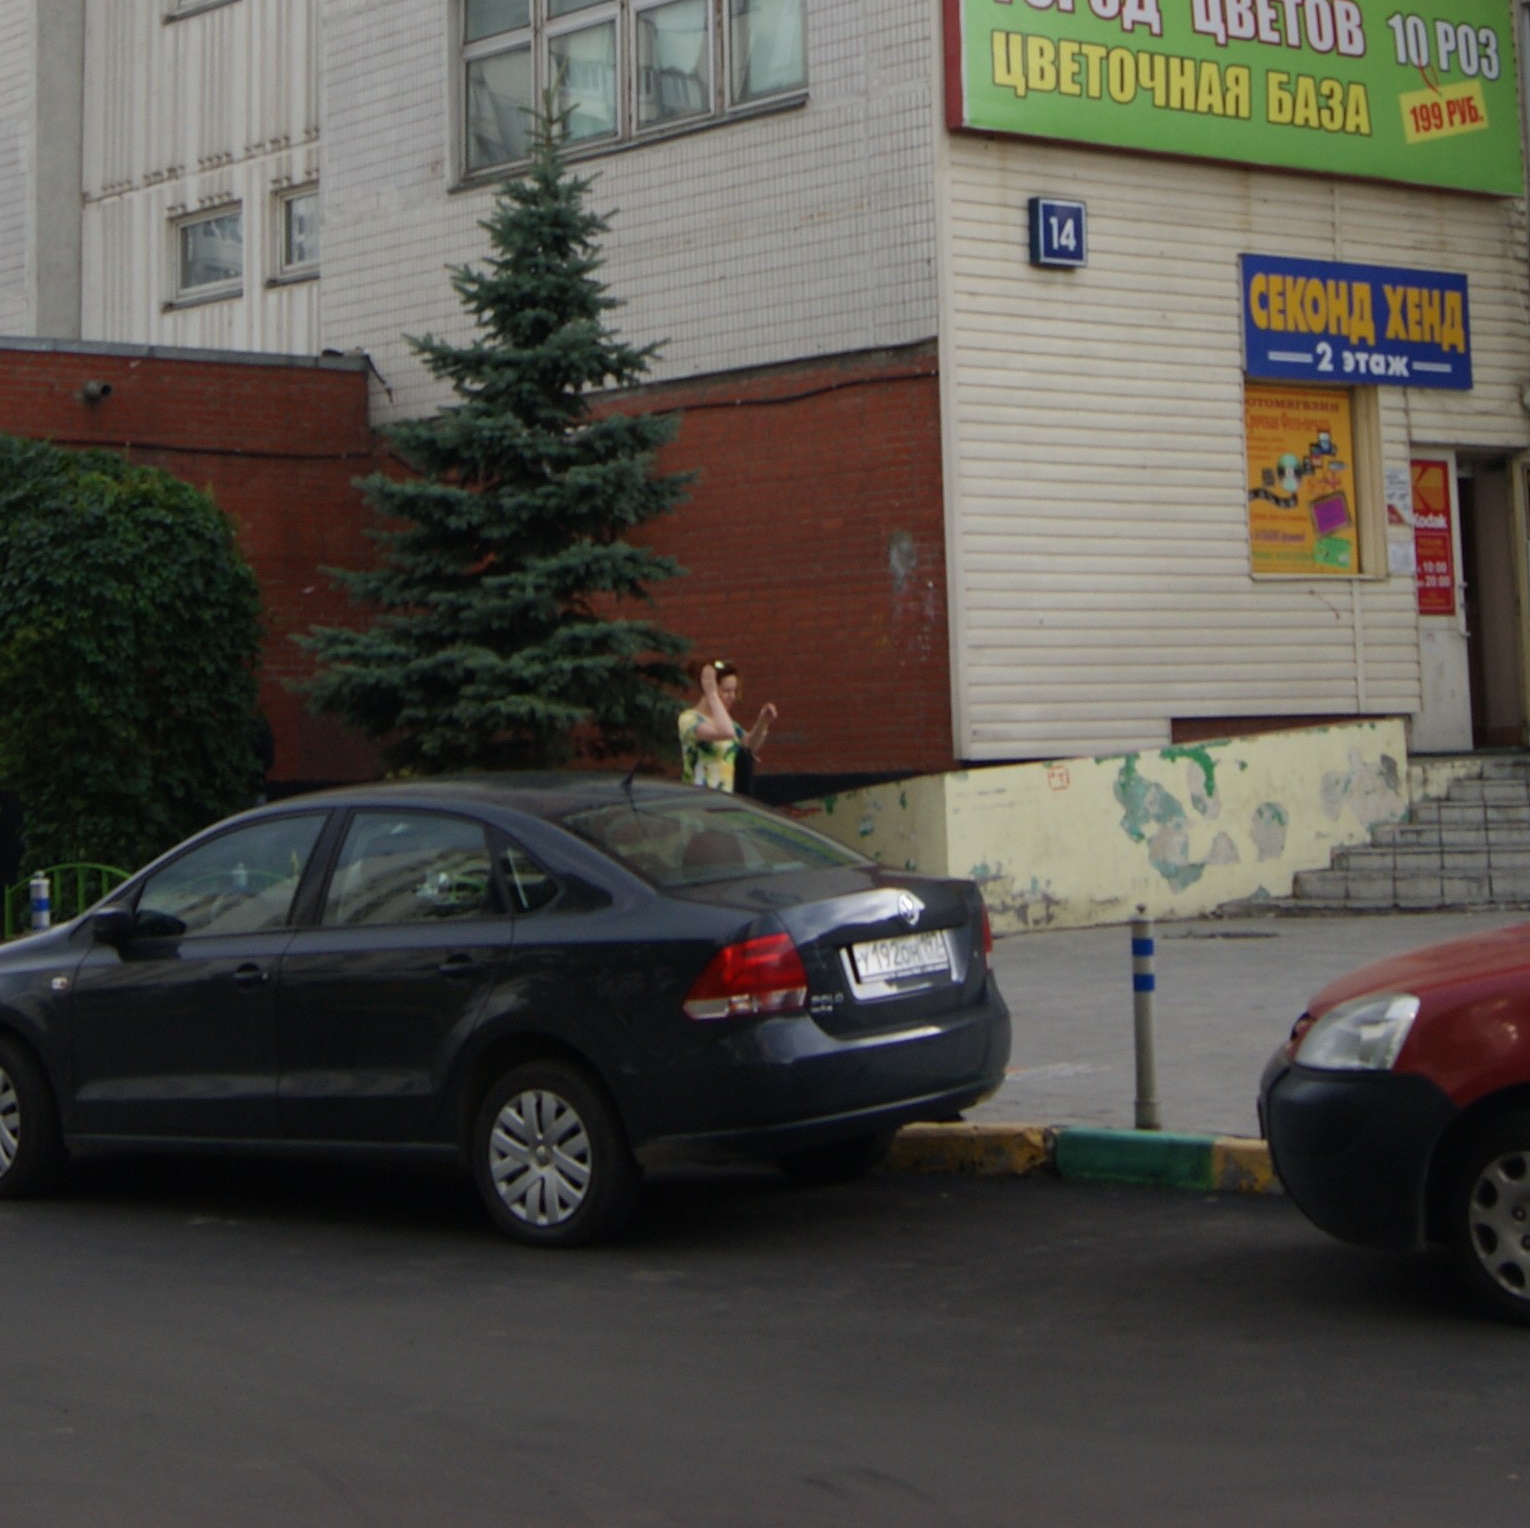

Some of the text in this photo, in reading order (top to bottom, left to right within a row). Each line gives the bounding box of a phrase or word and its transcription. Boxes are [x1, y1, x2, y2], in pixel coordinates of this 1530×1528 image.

[1386, 13, 1499, 80] 10 РОЗ
[991, 31, 1371, 136] ЦВЕТОЧНАЯ БАЗА
[1409, 96, 1484, 133] 199 РУБ.
[1048, 215, 1076, 252] 14
[1249, 274, 1465, 353] СЕКОНД ХЕНД
[1317, 343, 1409, 377] 2 этаж
